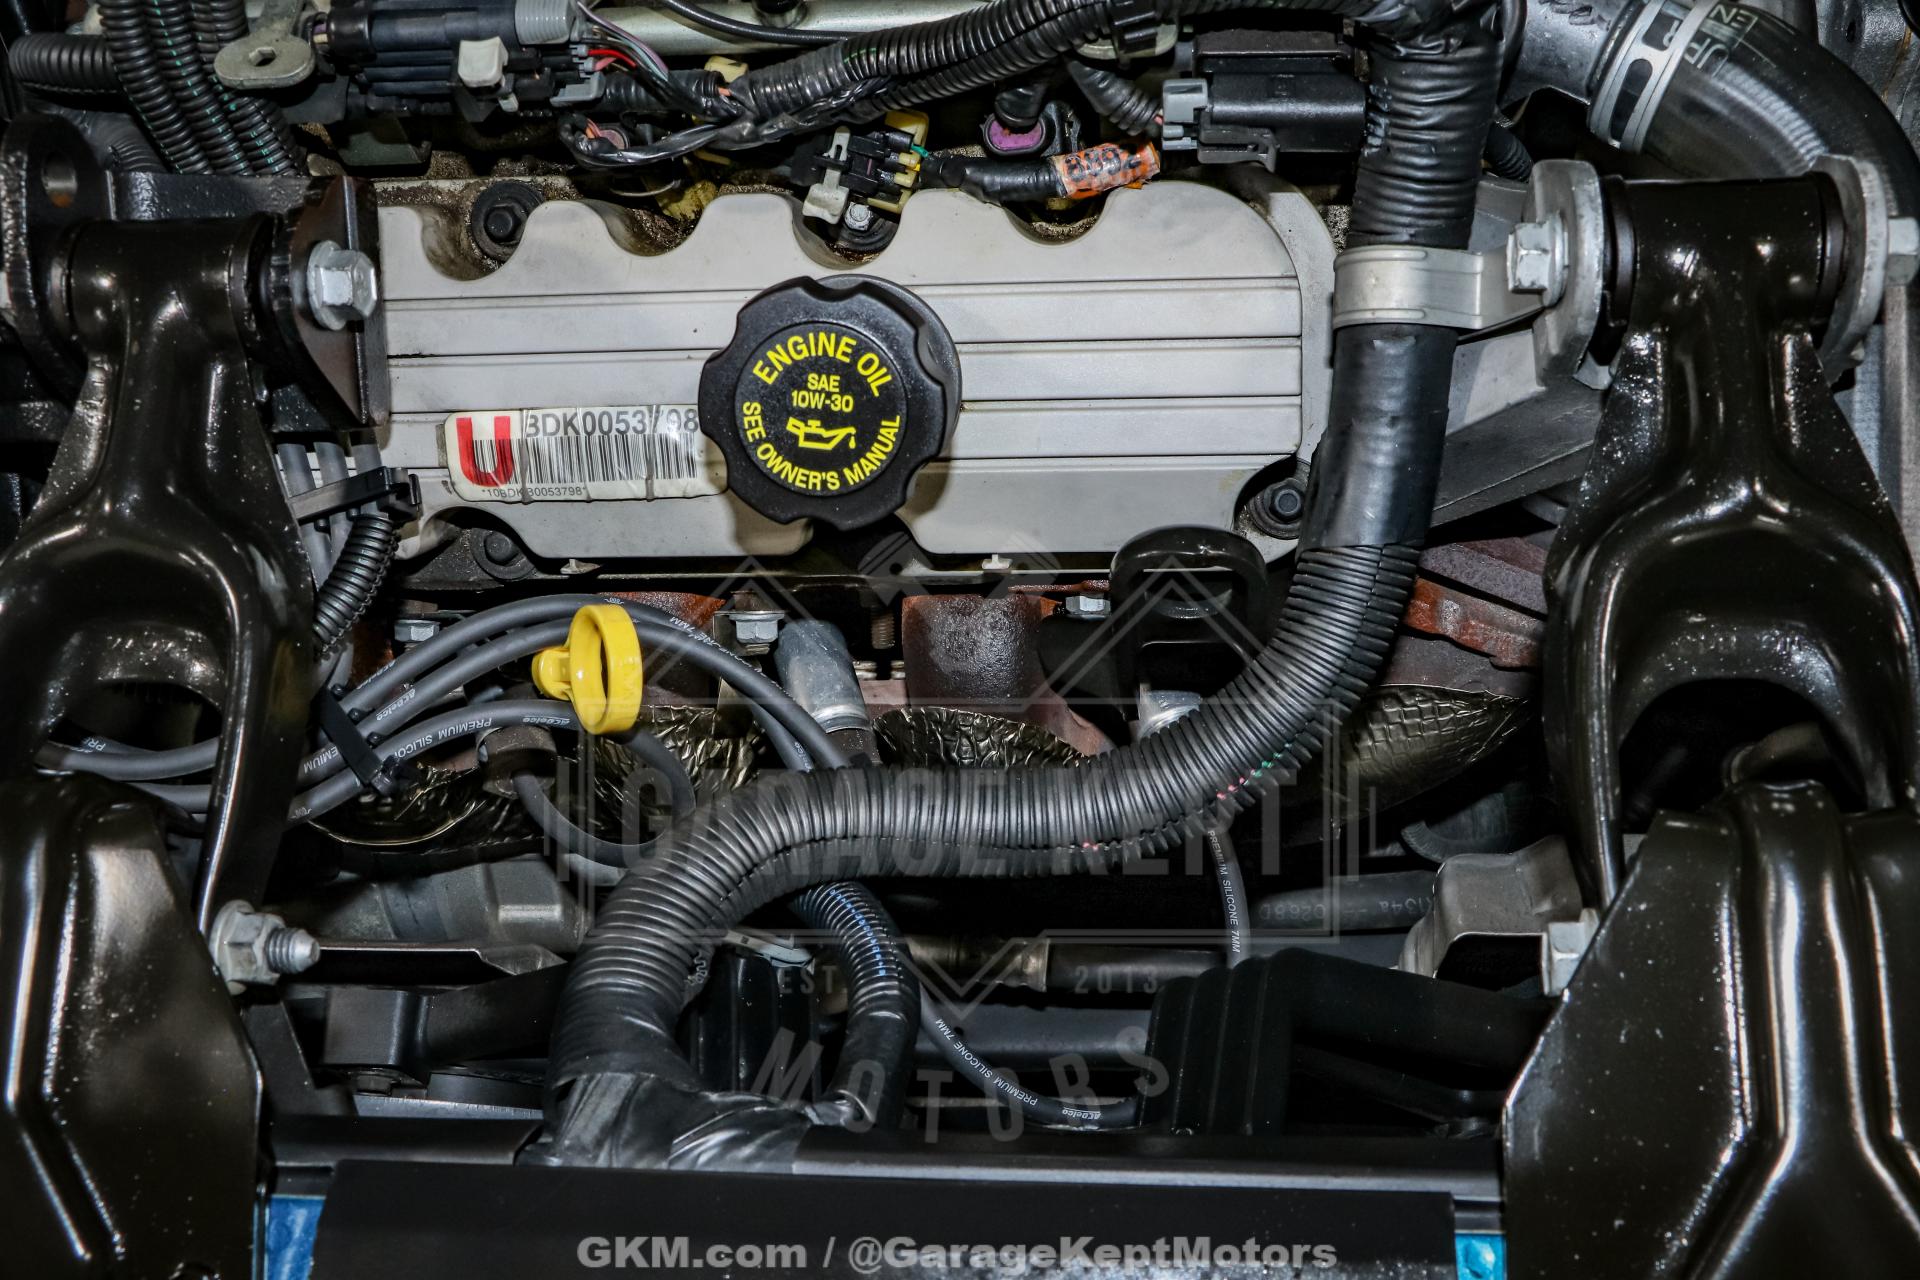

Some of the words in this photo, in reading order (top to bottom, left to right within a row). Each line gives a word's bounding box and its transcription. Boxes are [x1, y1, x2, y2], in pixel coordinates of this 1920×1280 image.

[1709, 4, 1758, 34] EN
[753, 332, 857, 385] ENGINE
[857, 353, 893, 397] OIL
[807, 373, 841, 392] SAE
[791, 390, 854, 413] 10W-30
[456, 416, 514, 487] U
[742, 401, 767, 443] SEE
[756, 443, 841, 491] OWNER'S
[843, 415, 900, 485] MANUAL
[670, 616, 696, 633] 7MM
[439, 718, 492, 740] PREMIUM
[304, 746, 338, 773] EMIUM
[1207, 830, 1227, 875] PREMIUM
[1223, 880, 1239, 925] SILICONE
[1231, 930, 1240, 953] 7MM
[935, 1018, 955, 1041] 7MM
[953, 1041, 993, 1078] SILICONE
[993, 1077, 1039, 1106] PREMIUM
